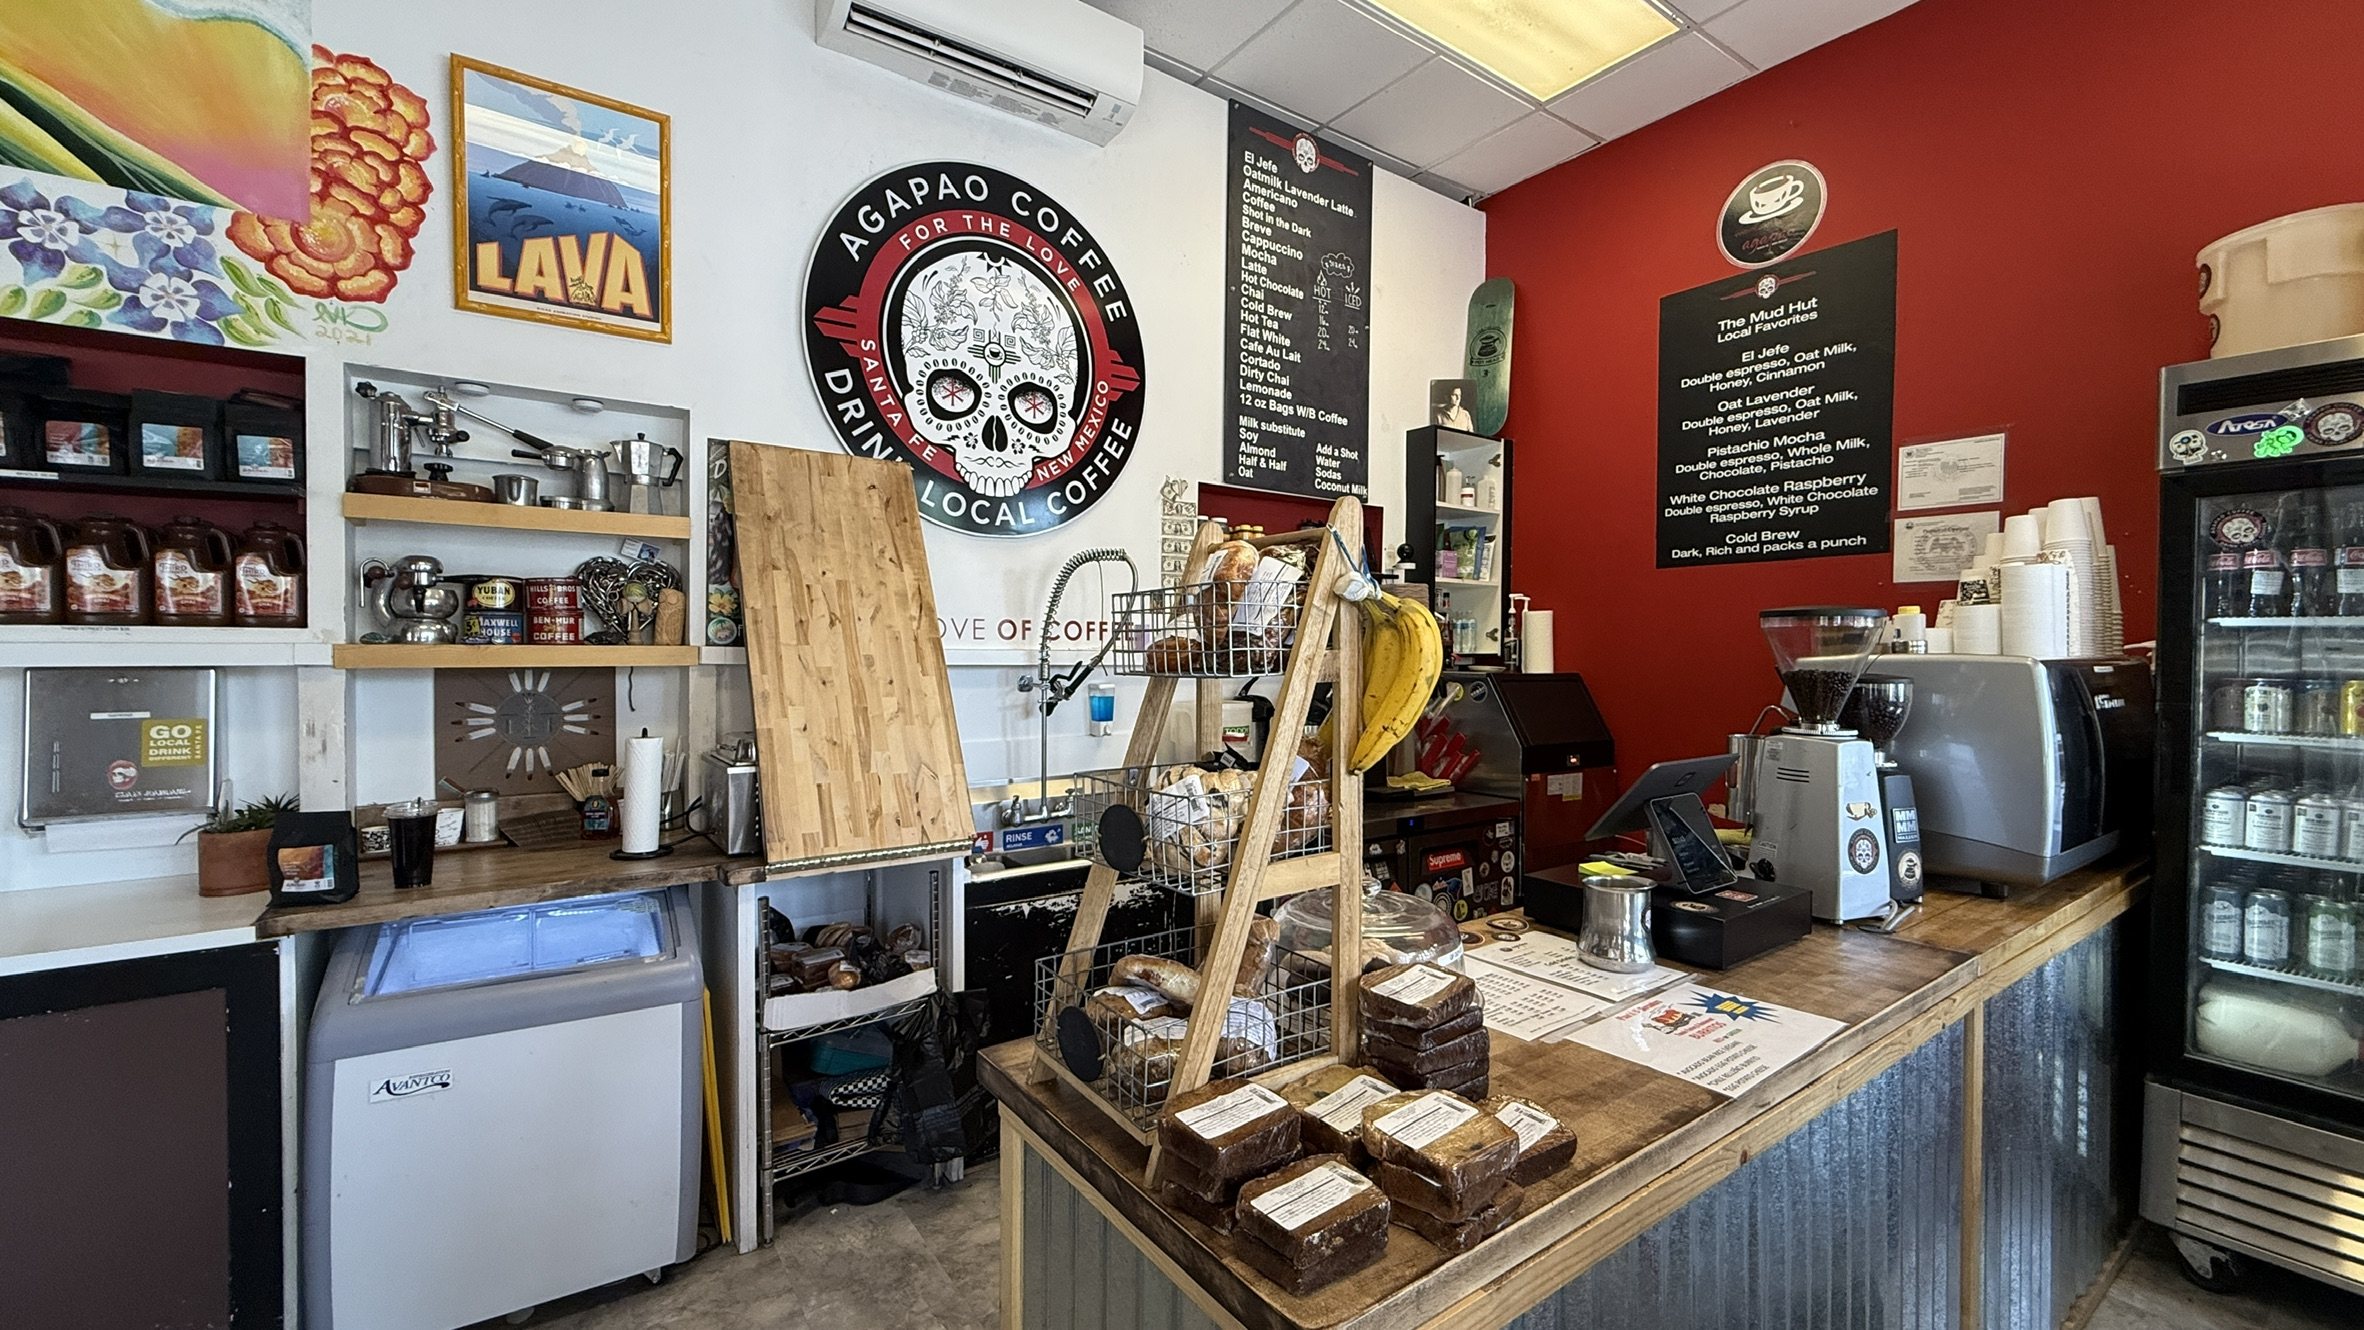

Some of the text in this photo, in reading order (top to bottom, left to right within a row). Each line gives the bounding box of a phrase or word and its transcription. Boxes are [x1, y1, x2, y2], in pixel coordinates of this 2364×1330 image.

[1245, 151, 1277, 173] El Jefe
[1242, 192, 1275, 212] Coffee
[1243, 166, 1354, 217] Oatmilk Lavender Latte
[1243, 179, 1298, 208] Americano
[1242, 204, 1311, 238] Shot in the Dark
[1242, 216, 1272, 236] Breve
[839, 174, 1127, 322] AGAPAO COFFEE
[899, 215, 1081, 292] FOR THE LOVE
[1242, 230, 1303, 260] Cappuccino
[1242, 243, 1277, 265] Mocha
[476, 232, 653, 318] LAVA
[1241, 257, 1267, 275] Latte
[1241, 270, 1304, 300] Hot Chocolate
[1241, 283, 1264, 300] Chai
[1314, 285, 1331, 299] HOT
[1241, 297, 1292, 321] Cold Brew
[1345, 293, 1362, 307] ICED
[1241, 310, 1279, 329] Hot Tea
[1718, 298, 1818, 331] The Mud Hut
[1241, 323, 1290, 347] Flat White
[1718, 311, 1818, 343] Local Favorites
[1240, 338, 1301, 363] Cafe Au Lait
[1742, 344, 1789, 362] El Jefe
[1240, 352, 1280, 371] Cortado
[1681, 342, 1857, 388] Double espresso, Oat Milk,
[1240, 365, 1289, 386] Dirty Chai
[1710, 360, 1825, 392] Honey, Cinnamon
[1240, 379, 1292, 399] Lemonade
[1718, 386, 1815, 412] Oat Lavender
[861, 340, 937, 461] SANTA FE
[1240, 395, 1348, 426] 12 oz Bags W/B Coffee
[1682, 390, 1858, 430] Double espresso, Oat Milk,
[1037, 380, 1109, 482] NEW MEXICO
[1240, 416, 1305, 437] Milk substitute
[1709, 409, 1820, 436] Honey, Lavender
[1240, 429, 1258, 443] Soy
[1708, 431, 1825, 457] Pistachio Mocha
[825, 368, 1132, 526] DRIN LOCAL COFFEE
[1240, 442, 1276, 458] Almond
[1316, 443, 1358, 460] Add a Shot
[1676, 437, 1870, 473] Double espresso, Whole Milk,
[1239, 456, 1287, 471] Half & Half
[1239, 467, 1253, 478] Oat
[1316, 456, 1340, 468] Water
[1700, 455, 1834, 480] Chocolate, Pistachio
[1316, 468, 1341, 479] Sodas
[1315, 479, 1367, 495] Coconut Milk
[1670, 473, 1866, 505] White Chocolate Raspberry
[1665, 486, 1878, 517] Double espresso, White Chocolate
[1710, 505, 1819, 523] Raspberry Syrup
[1672, 536, 1866, 558] Dark, Rich and packs a punch
[1726, 531, 1800, 544] Cold Brew
[478, 585, 510, 595] YUBAN
[537, 597, 569, 605] COFFEE
[533, 617, 575, 625] BEN-HUR
[997, 619, 1032, 640] OF
[533, 633, 575, 641] COFFEE
[149, 725, 192, 739] GO
[149, 748, 192, 756] DRINK
[1006, 832, 1032, 843] RINSE
[1429, 851, 1462, 867] Supreme
[372, 1074, 450, 1096] AVANTCO
